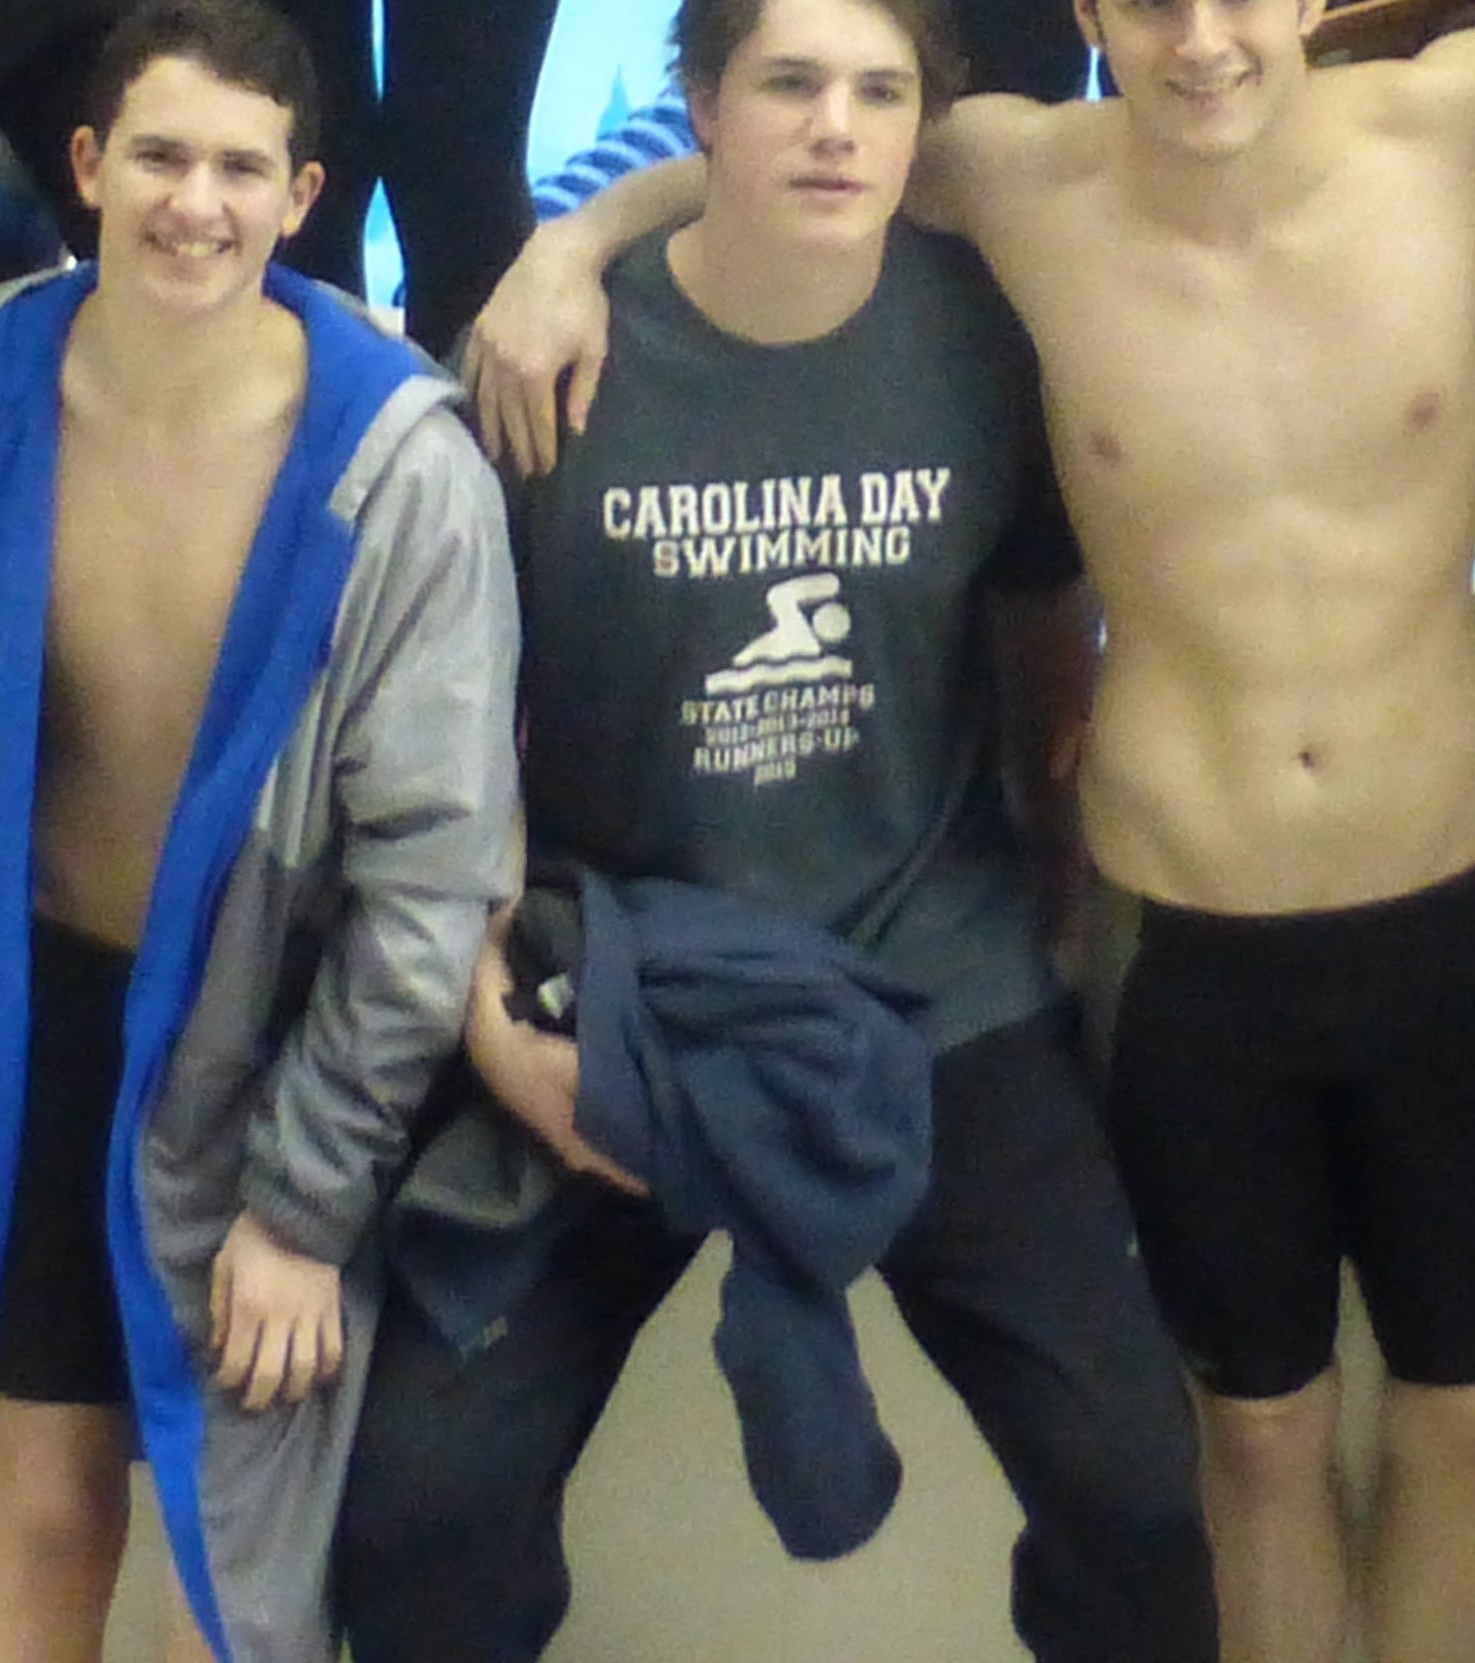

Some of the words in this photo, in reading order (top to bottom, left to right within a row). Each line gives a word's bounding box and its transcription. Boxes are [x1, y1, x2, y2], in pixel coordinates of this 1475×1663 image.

[602, 474, 848, 539] CAROLINA
[860, 467, 951, 524] DAY
[653, 525, 912, 578] SWIMMING
[681, 691, 759, 726] STATE
[763, 683, 875, 714] CHAMPS
